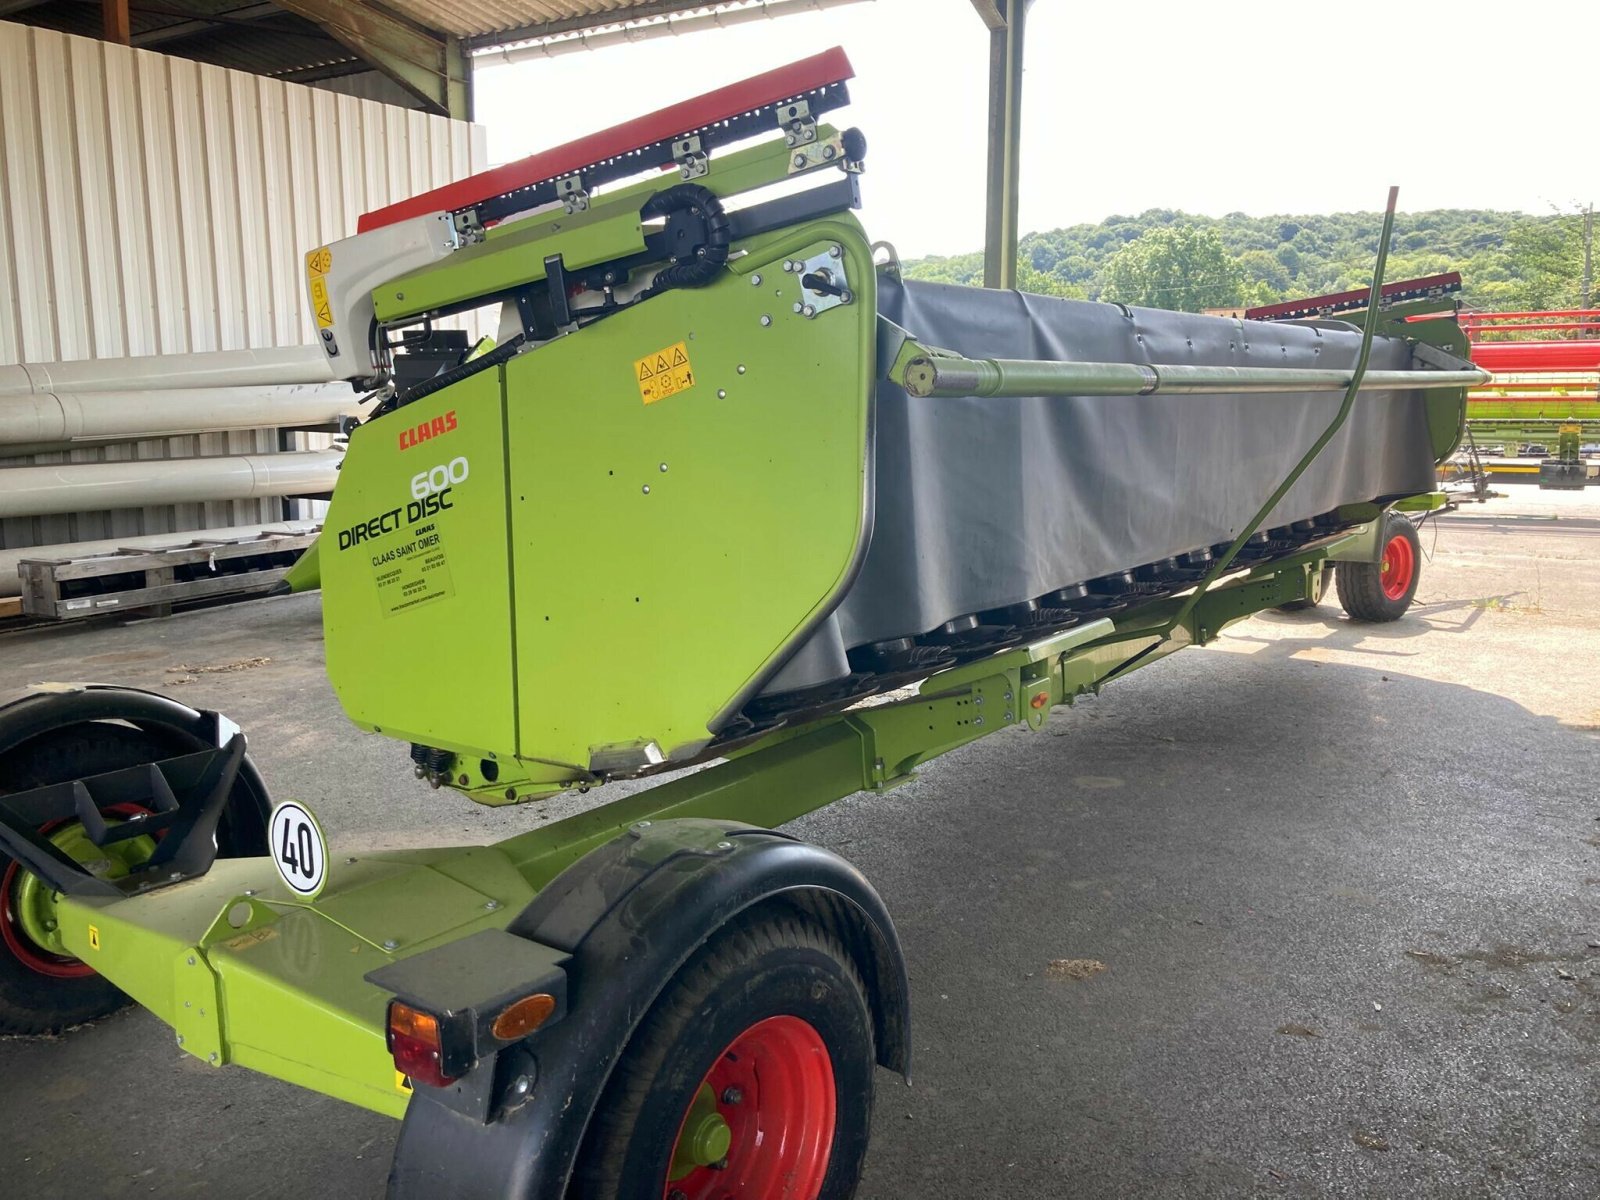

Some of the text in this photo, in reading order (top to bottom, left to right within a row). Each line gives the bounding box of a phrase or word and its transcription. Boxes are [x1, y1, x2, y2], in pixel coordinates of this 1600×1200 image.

[399, 410, 457, 451] CLAAS
[411, 456, 469, 500] 600
[338, 488, 454, 551] DIRECT DISC
[415, 523, 435, 536] CLAAS
[372, 550, 396, 567] CLAAS
[395, 542, 417, 558] SAINT
[418, 533, 440, 549] OMER
[282, 818, 314, 879] 40
